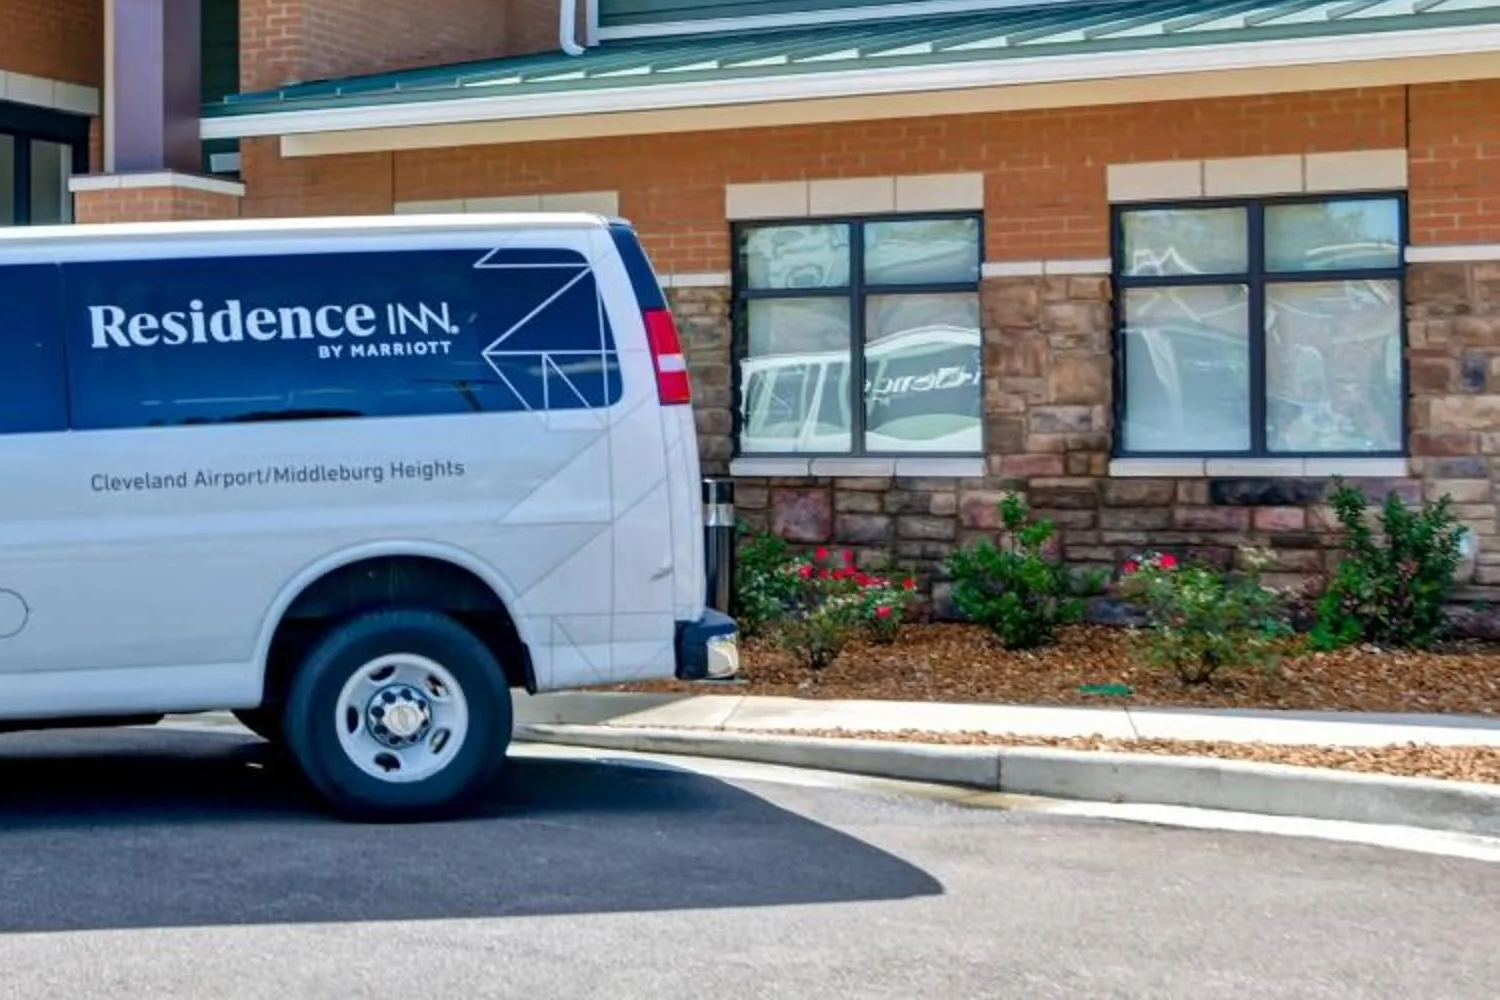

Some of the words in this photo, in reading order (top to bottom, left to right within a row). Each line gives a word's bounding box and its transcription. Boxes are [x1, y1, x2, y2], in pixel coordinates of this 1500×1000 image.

[88, 299, 377, 349] Residence
[317, 343, 344, 360] BY
[350, 340, 452, 359] MARRIOTT
[90, 471, 188, 492] Cleveland
[194, 462, 385, 489] Airport/Middleburg
[390, 460, 466, 482] Heights
